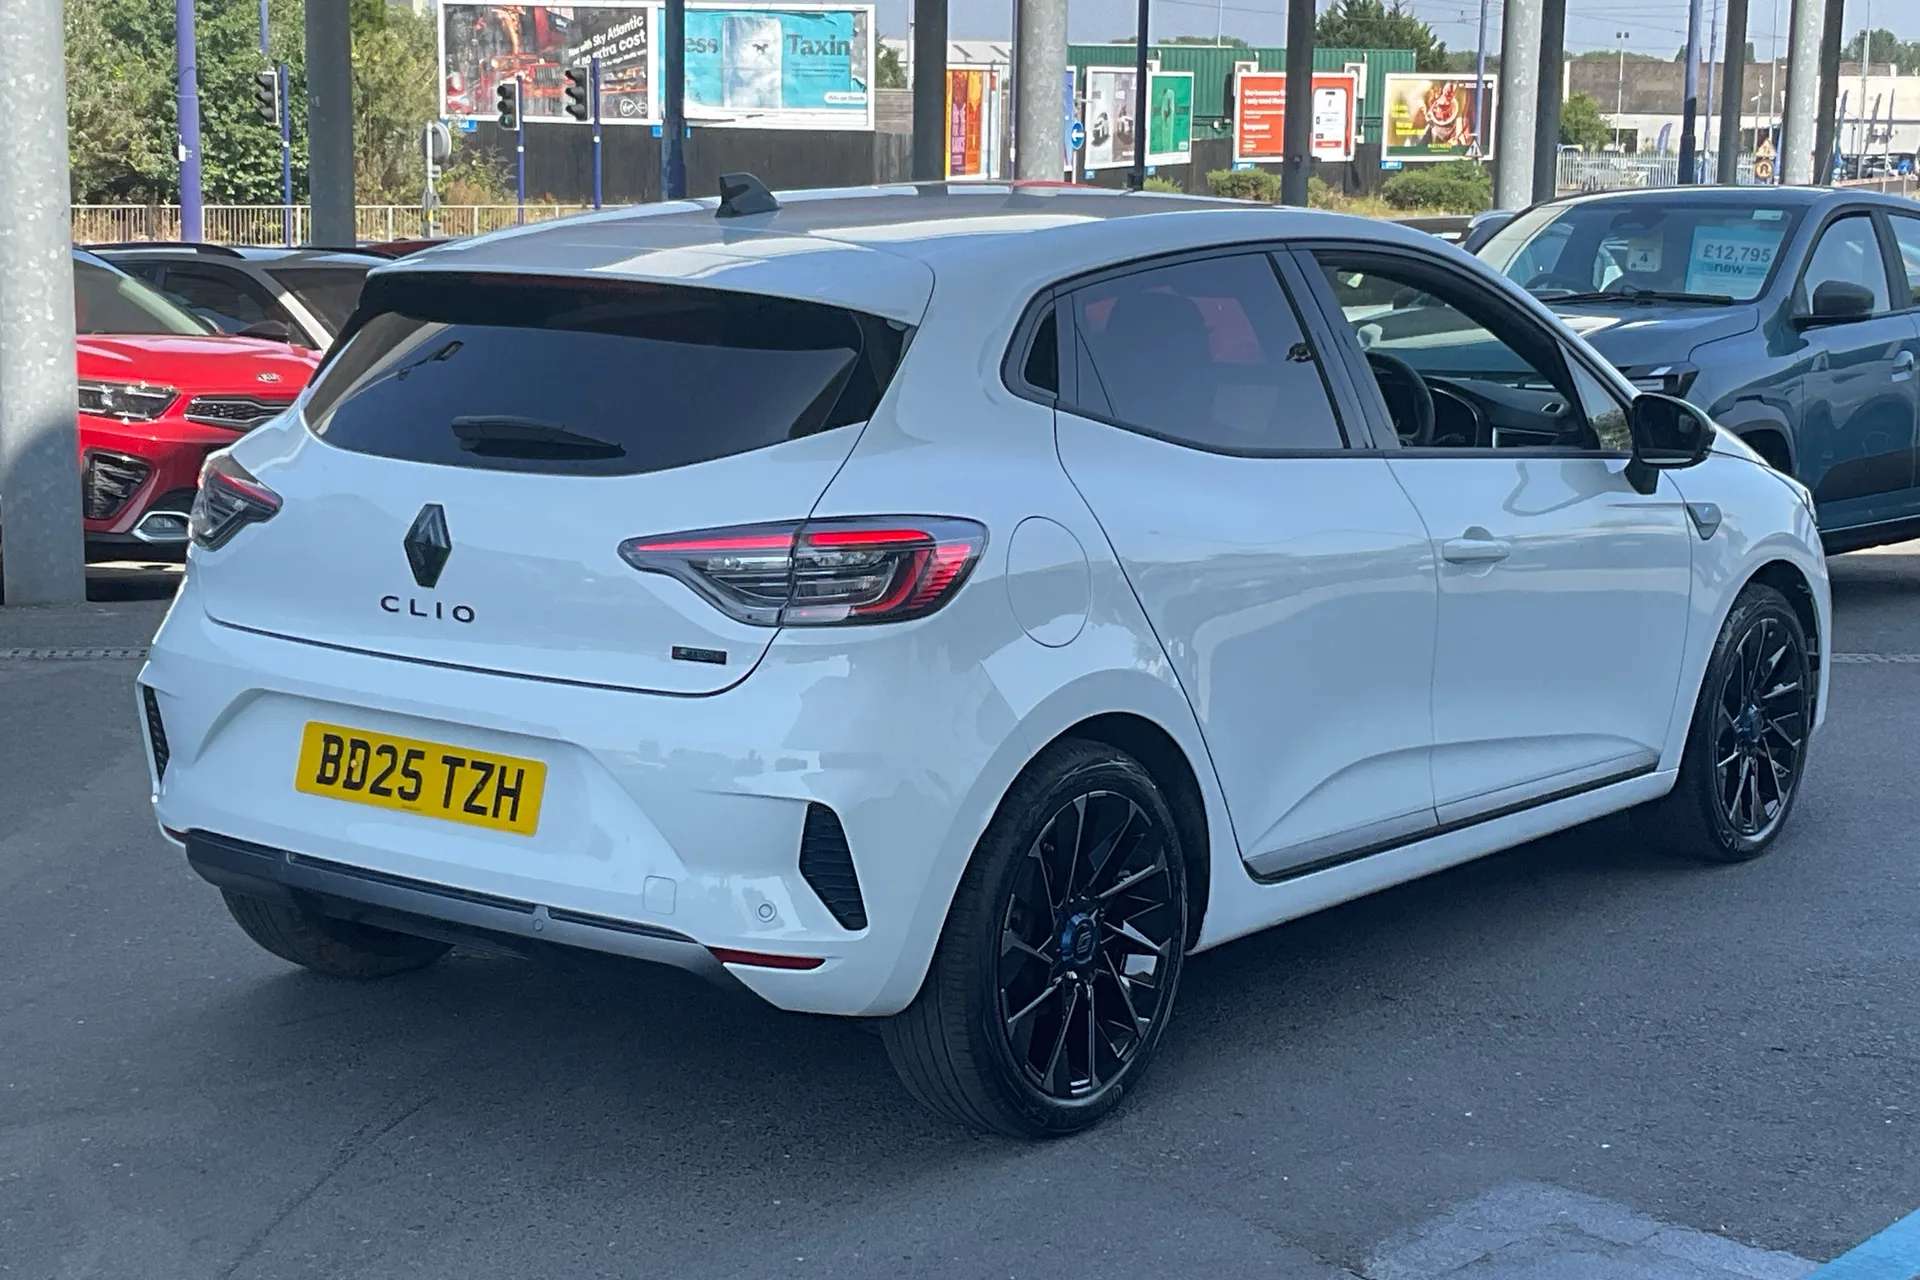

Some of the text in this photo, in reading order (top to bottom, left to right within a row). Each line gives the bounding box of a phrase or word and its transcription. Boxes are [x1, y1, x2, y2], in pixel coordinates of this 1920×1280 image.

[592, 33, 606, 47] Sky
[607, 15, 644, 41] Atlantic
[685, 38, 718, 54] ess
[581, 54, 592, 66] no
[619, 29, 646, 51] cost
[1703, 244, 1771, 263] £12,795
[380, 595, 475, 623] CLIO
[316, 733, 525, 822] BD25 TZH
